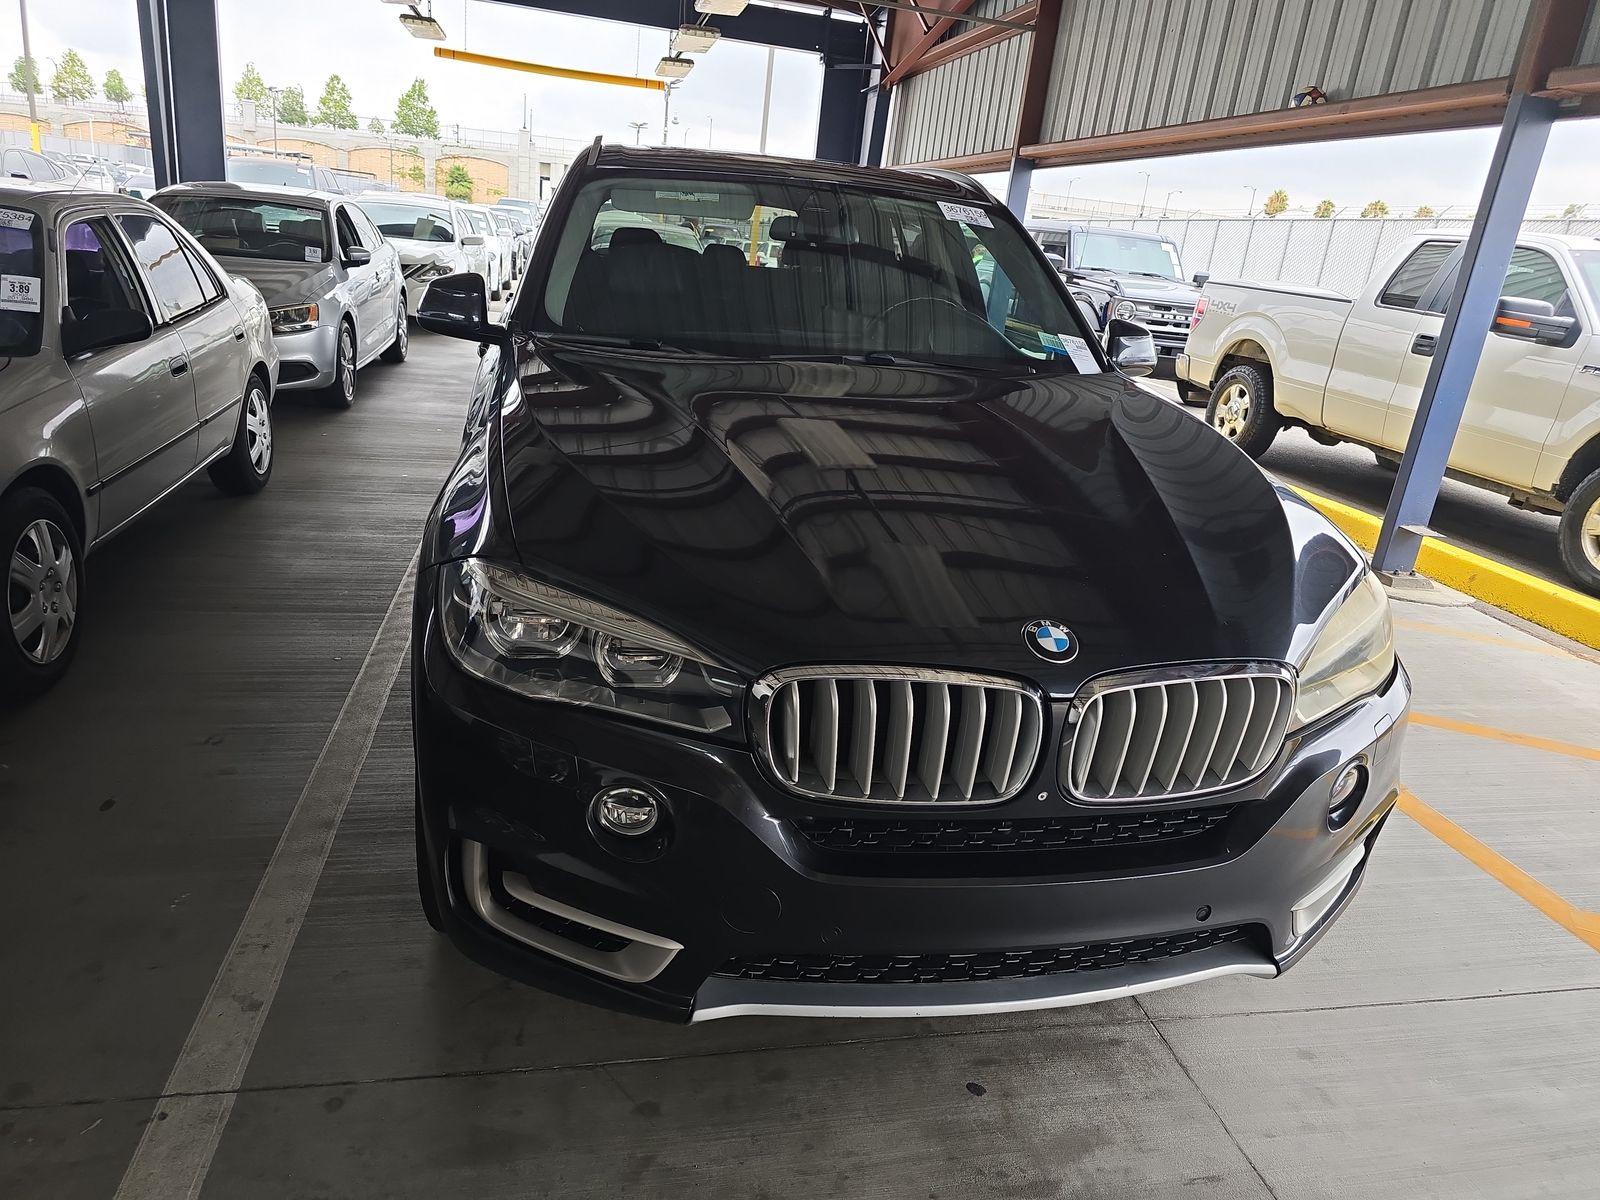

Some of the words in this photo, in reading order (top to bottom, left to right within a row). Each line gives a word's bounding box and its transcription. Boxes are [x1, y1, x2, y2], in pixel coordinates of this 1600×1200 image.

[0, 210, 32, 222] 5384
[10, 283, 30, 293] 3:89
[1027, 620, 1070, 633] BMW
